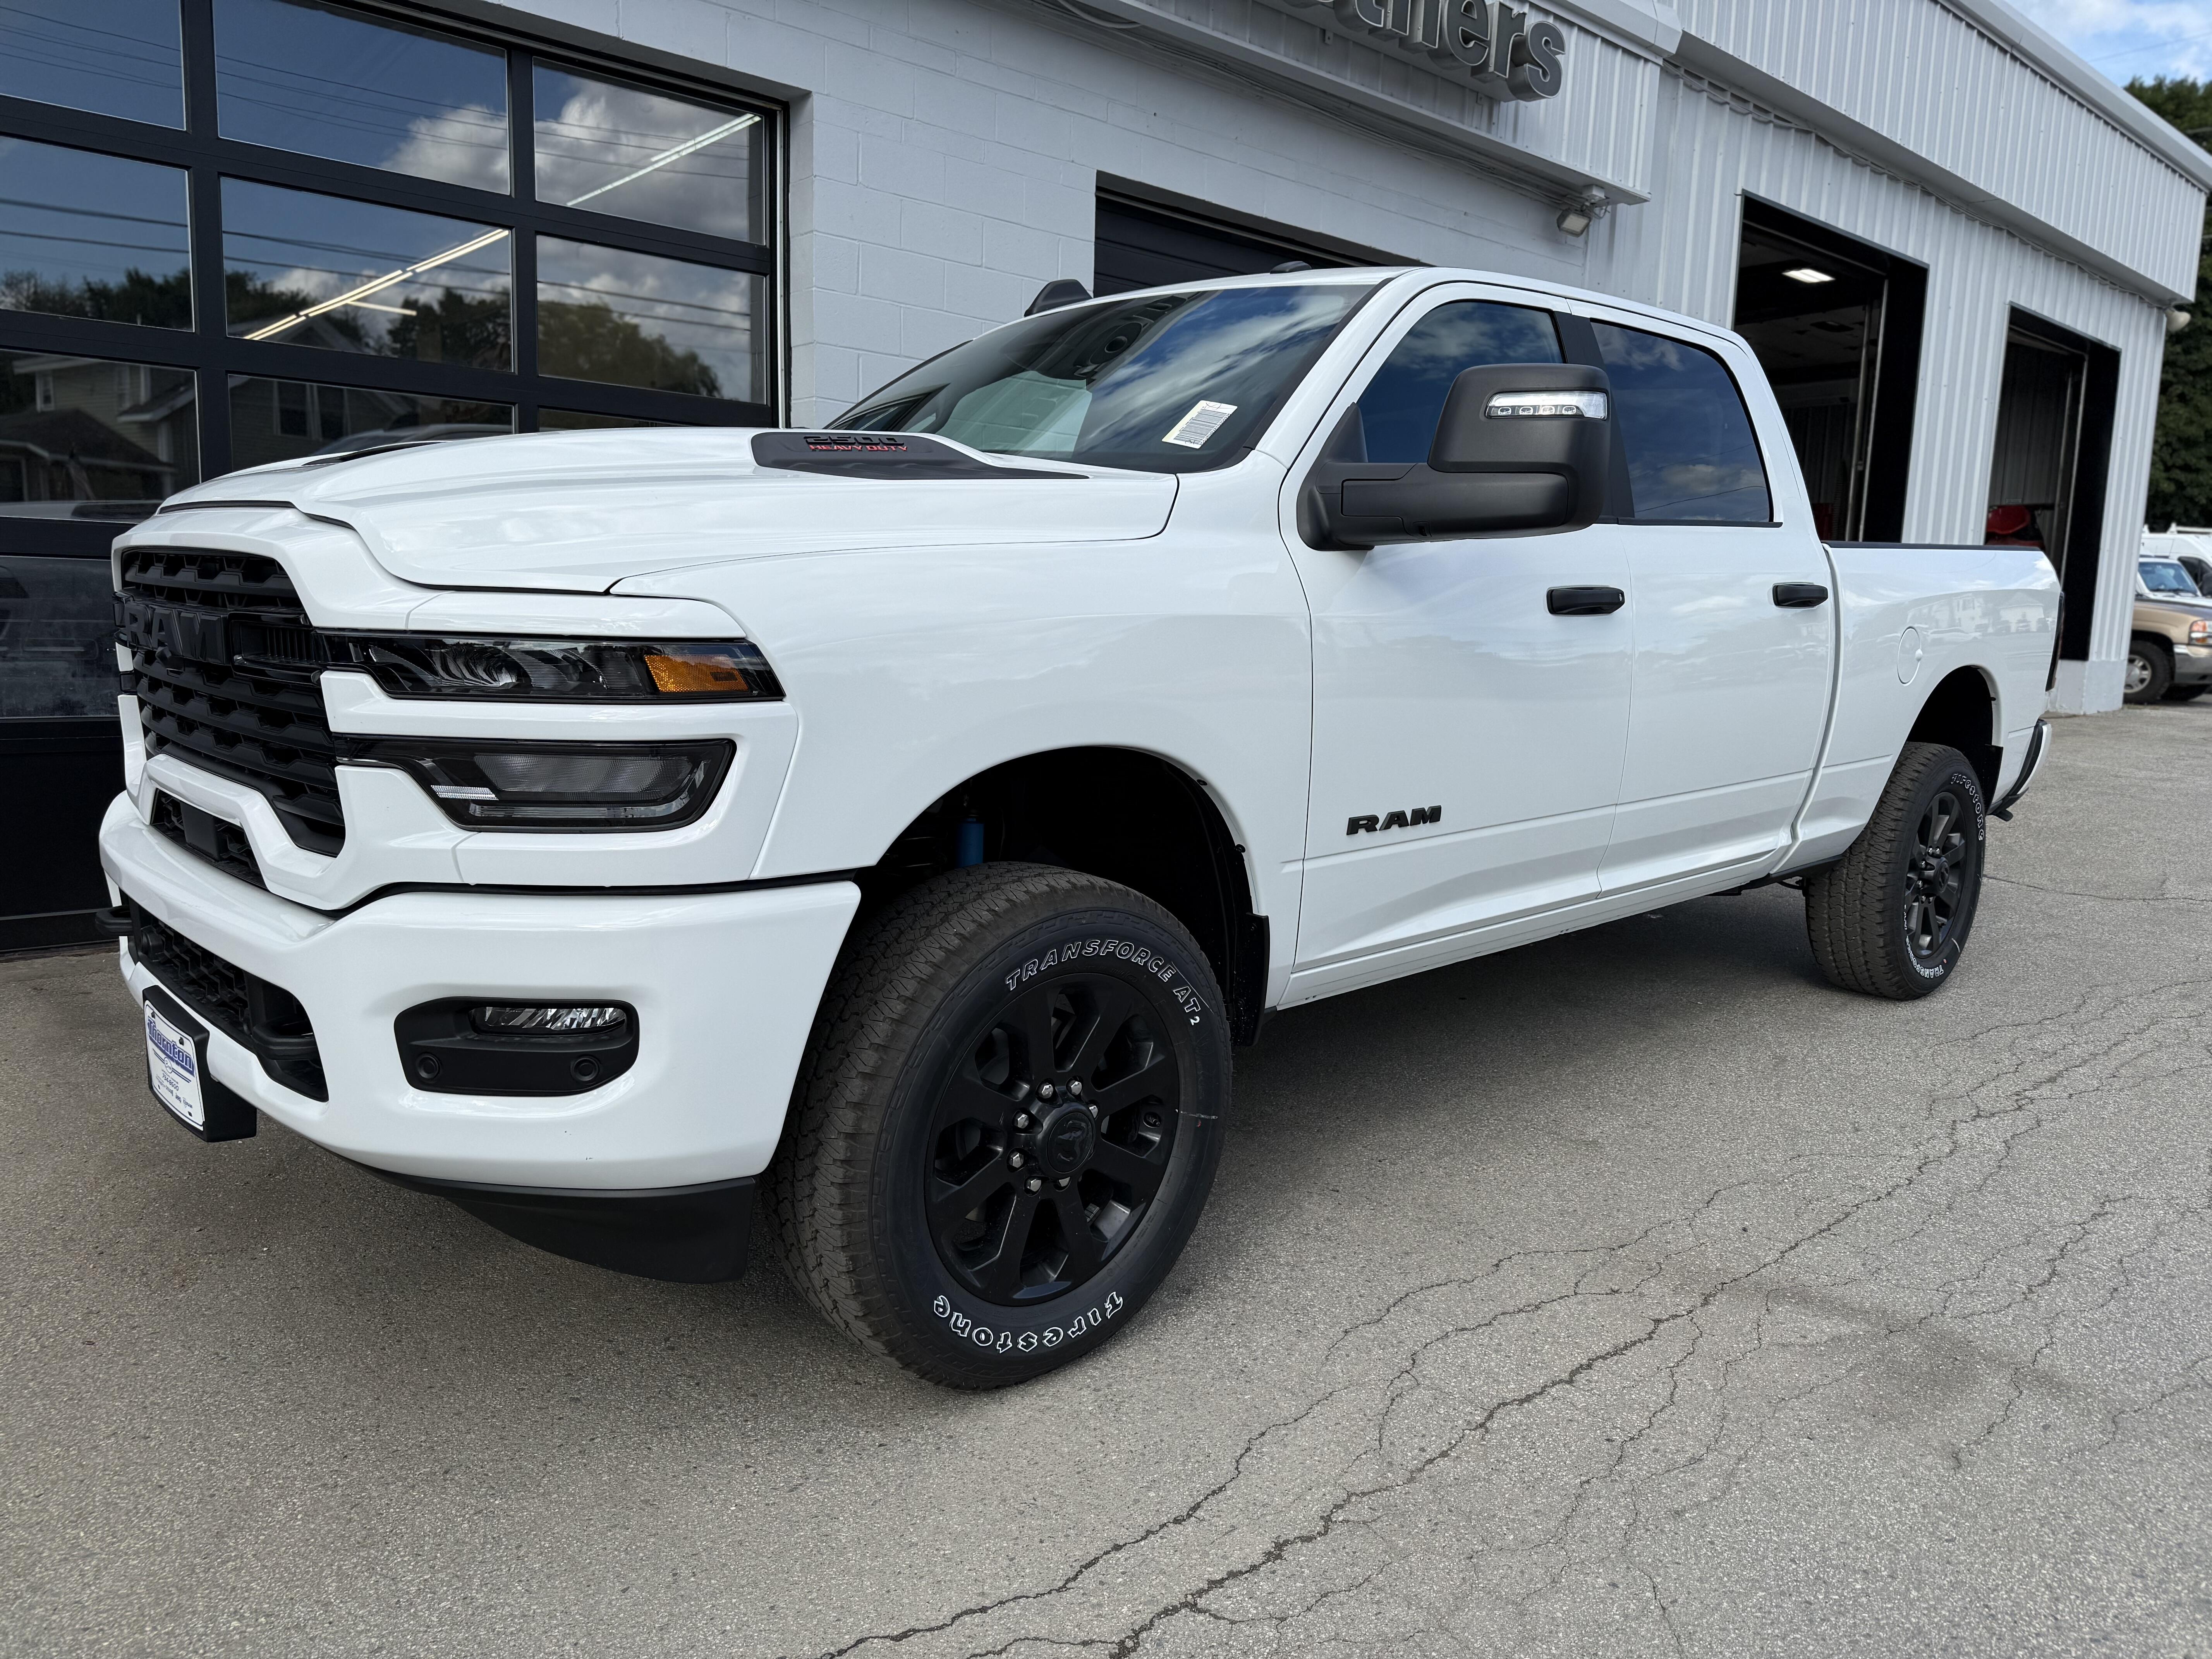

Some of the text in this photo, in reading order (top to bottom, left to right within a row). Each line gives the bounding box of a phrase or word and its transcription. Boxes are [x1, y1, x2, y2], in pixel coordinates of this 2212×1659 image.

[1288, 0, 1566, 101] ers
[804, 436, 904, 445] 2500
[126, 601, 224, 664] RAM
[1346, 805, 1441, 835] RAM
[1005, 939, 1176, 991] TRANSFORCE
[148, 1018, 192, 1071] Thornton
[934, 1291, 1123, 1353] Firestone
